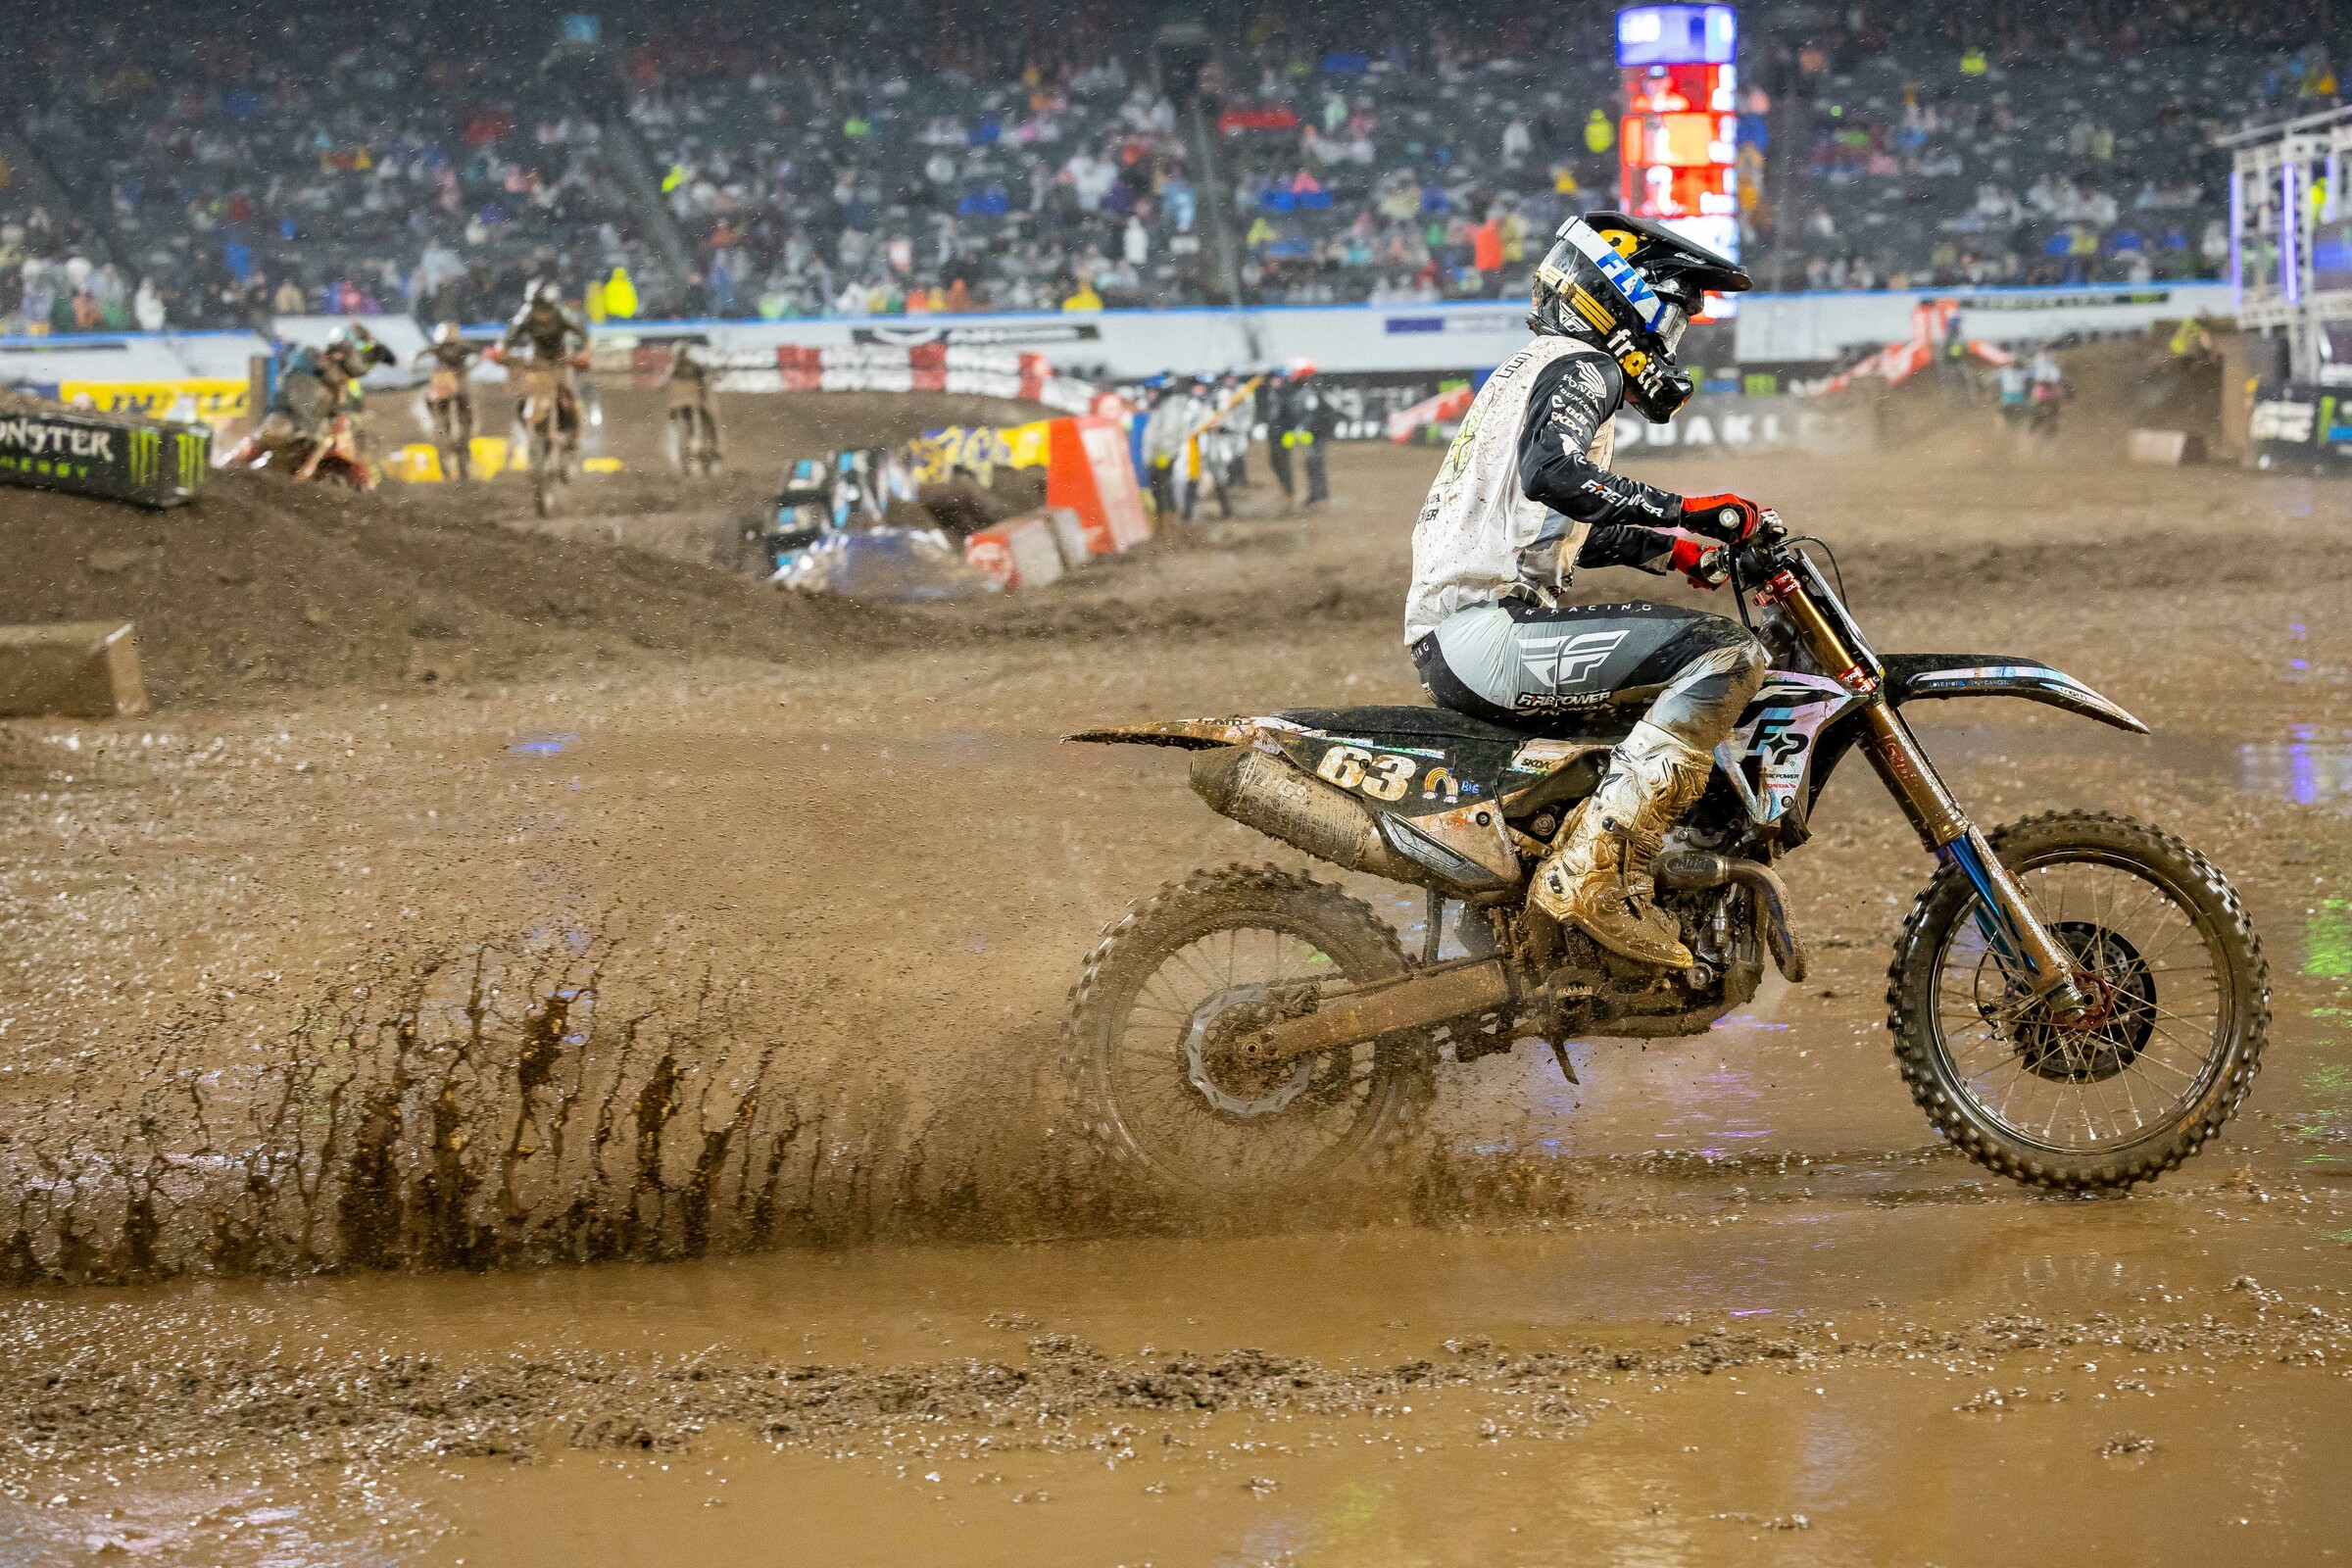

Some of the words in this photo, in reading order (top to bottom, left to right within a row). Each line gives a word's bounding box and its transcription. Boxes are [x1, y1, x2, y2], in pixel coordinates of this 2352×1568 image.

[1595, 249, 1656, 305] FLY
[1517, 690, 1611, 707] FIREPOWER
[1316, 746, 1416, 802] 63
